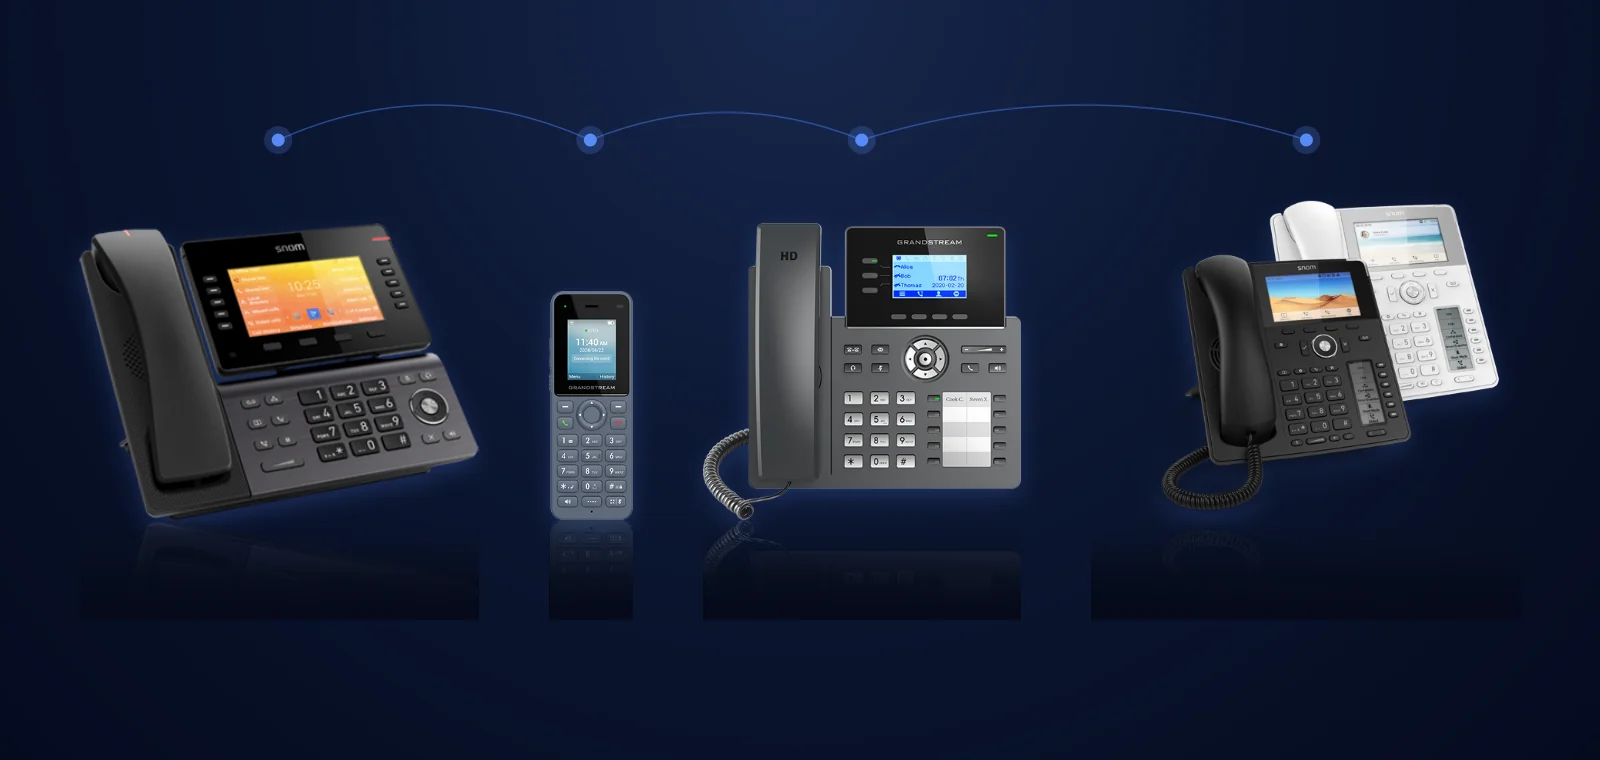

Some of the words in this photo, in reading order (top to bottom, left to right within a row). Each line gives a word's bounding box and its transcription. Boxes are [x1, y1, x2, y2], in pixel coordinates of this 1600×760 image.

[274, 242, 306, 253] snom
[780, 252, 798, 260] HD
[288, 279, 321, 292] 10:25
[347, 385, 355, 395] 2
[378, 380, 386, 390] 3
[316, 390, 322, 399] 1
[386, 398, 393, 407] 6
[323, 408, 330, 417] 4
[353, 403, 361, 413] 5
[360, 421, 368, 431] 8
[392, 416, 399, 426] 9
[329, 426, 335, 436] 7
[400, 434, 407, 444] #
[367, 440, 375, 450] 0
